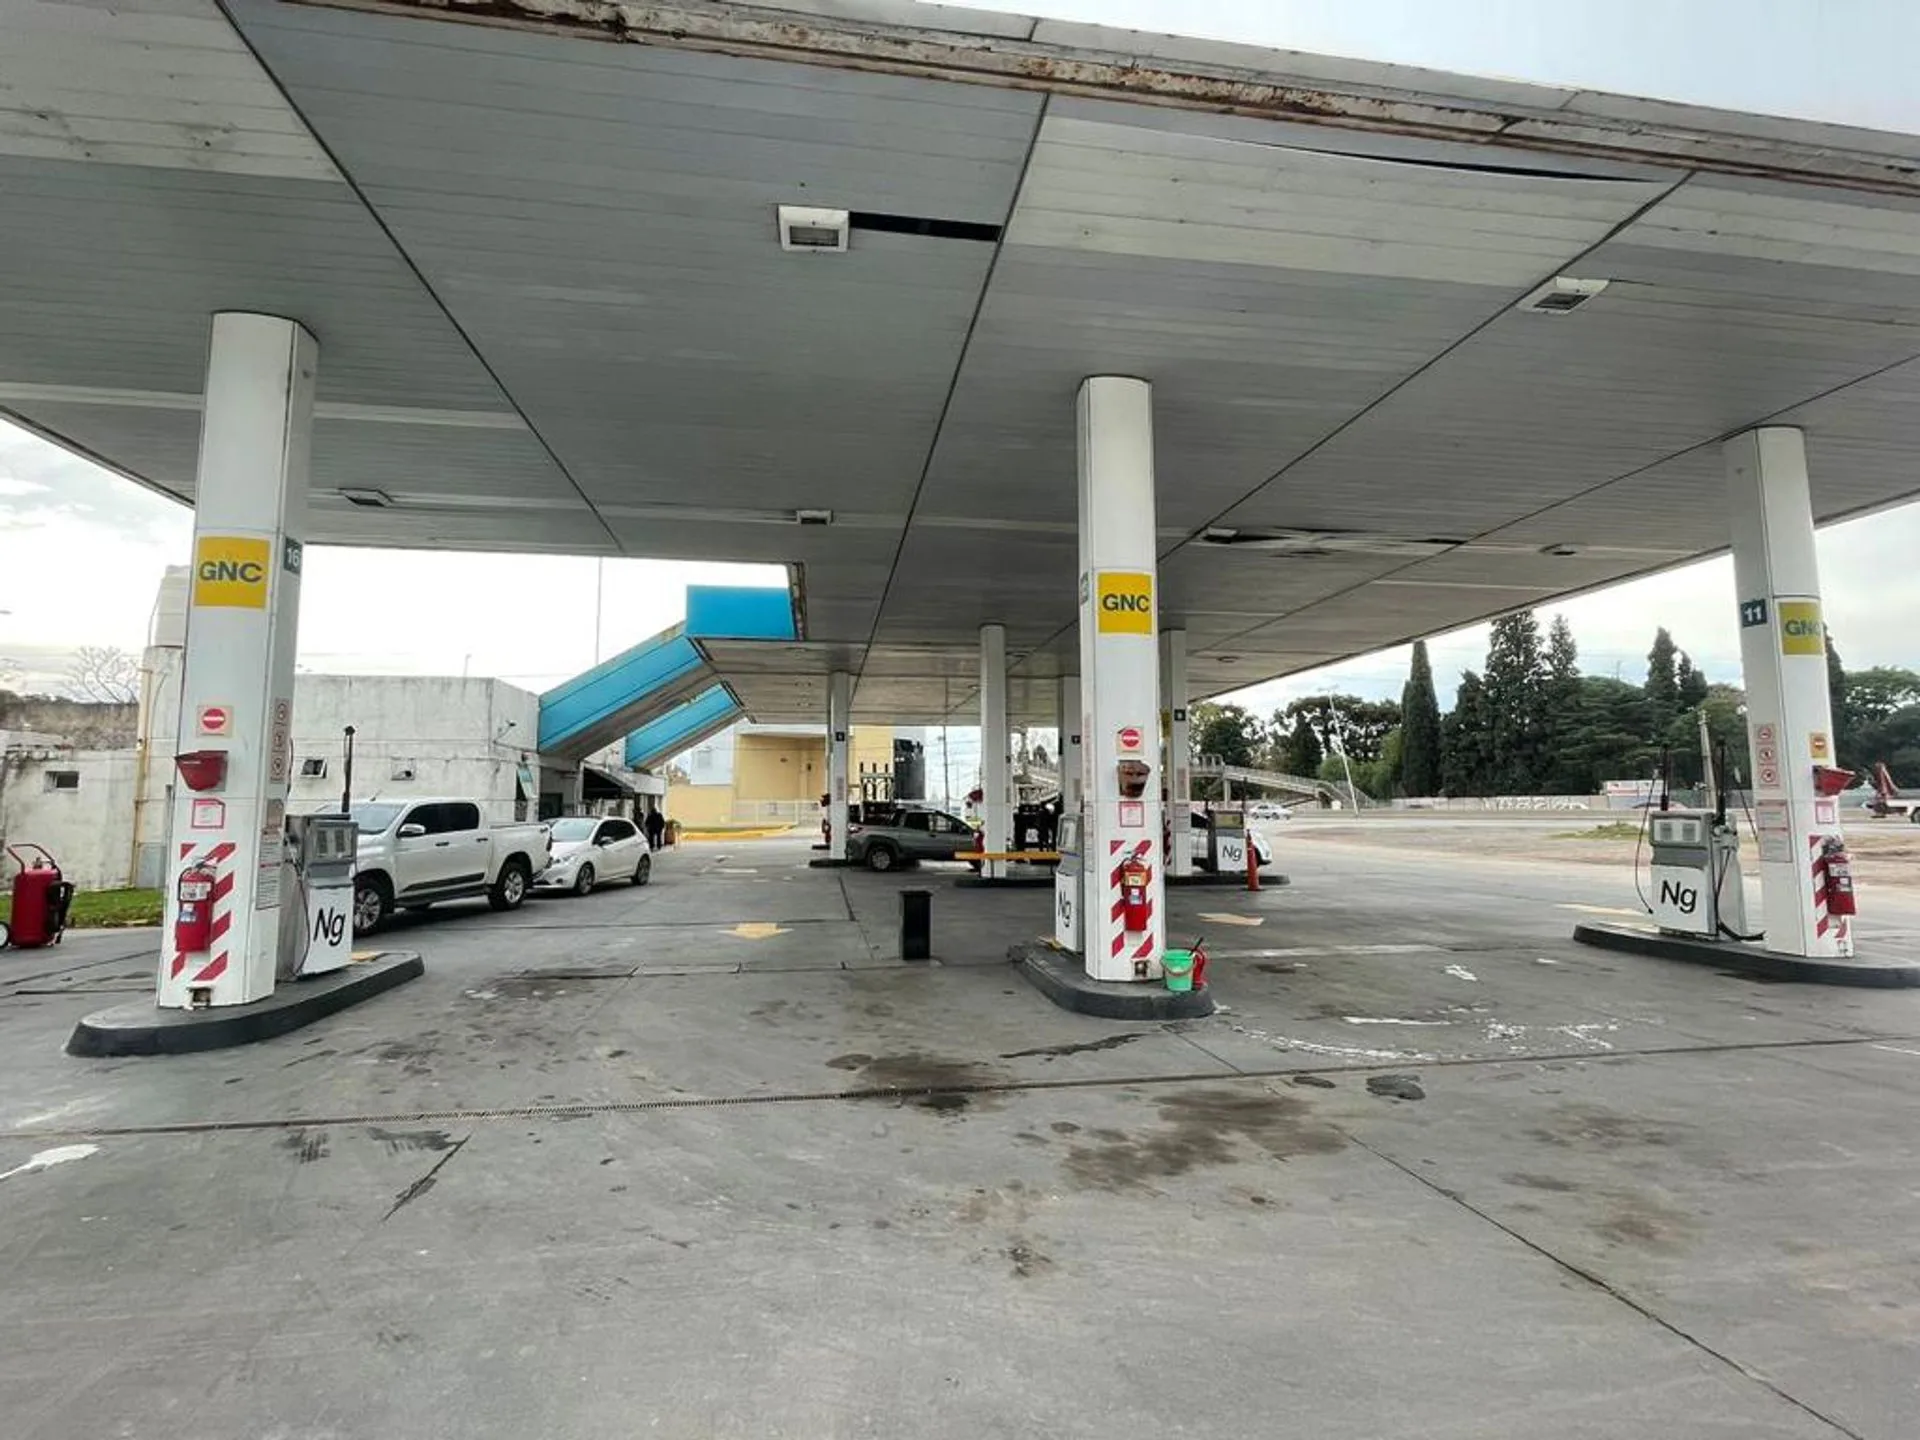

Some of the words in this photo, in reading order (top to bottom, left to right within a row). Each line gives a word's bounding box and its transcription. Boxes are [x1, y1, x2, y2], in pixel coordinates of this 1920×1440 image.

[286, 547, 301, 568] 16
[199, 560, 263, 583] GNC
[1102, 593, 1149, 613] GNC
[1744, 606, 1762, 622] 11
[1222, 844, 1243, 862] Ng
[1661, 880, 1697, 914] Ng
[313, 906, 346, 947] Ng
